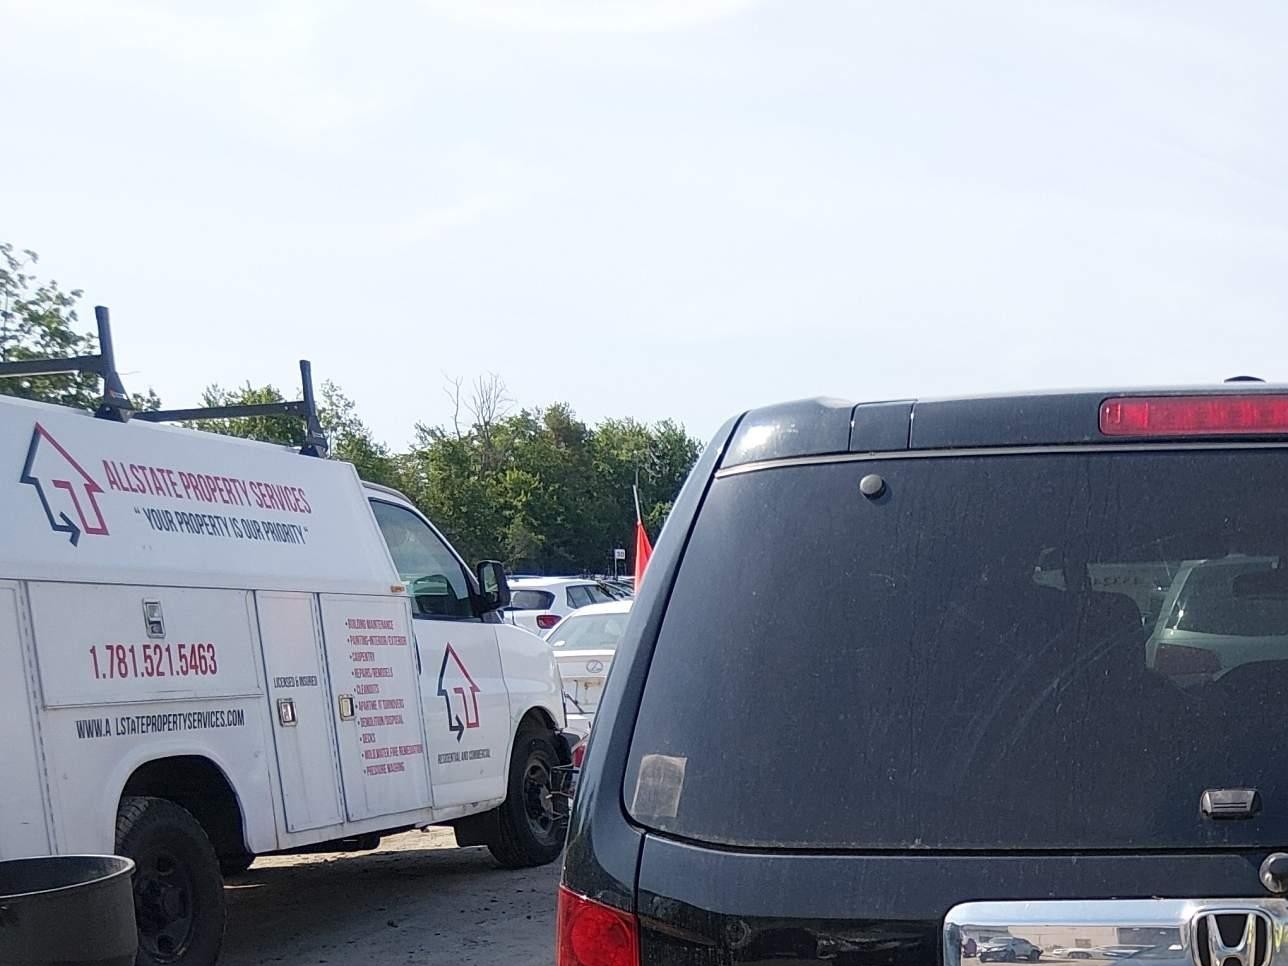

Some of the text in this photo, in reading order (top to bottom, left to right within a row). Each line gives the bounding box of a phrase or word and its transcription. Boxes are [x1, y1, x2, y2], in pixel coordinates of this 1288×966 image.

[102, 460, 312, 514] ALLSTATE PROPERTY SERVICES
[174, 510, 230, 537] PROPERTY
[229, 517, 244, 538] IS
[240, 518, 264, 541] OUR
[89, 643, 218, 679] 1.781.521.5463
